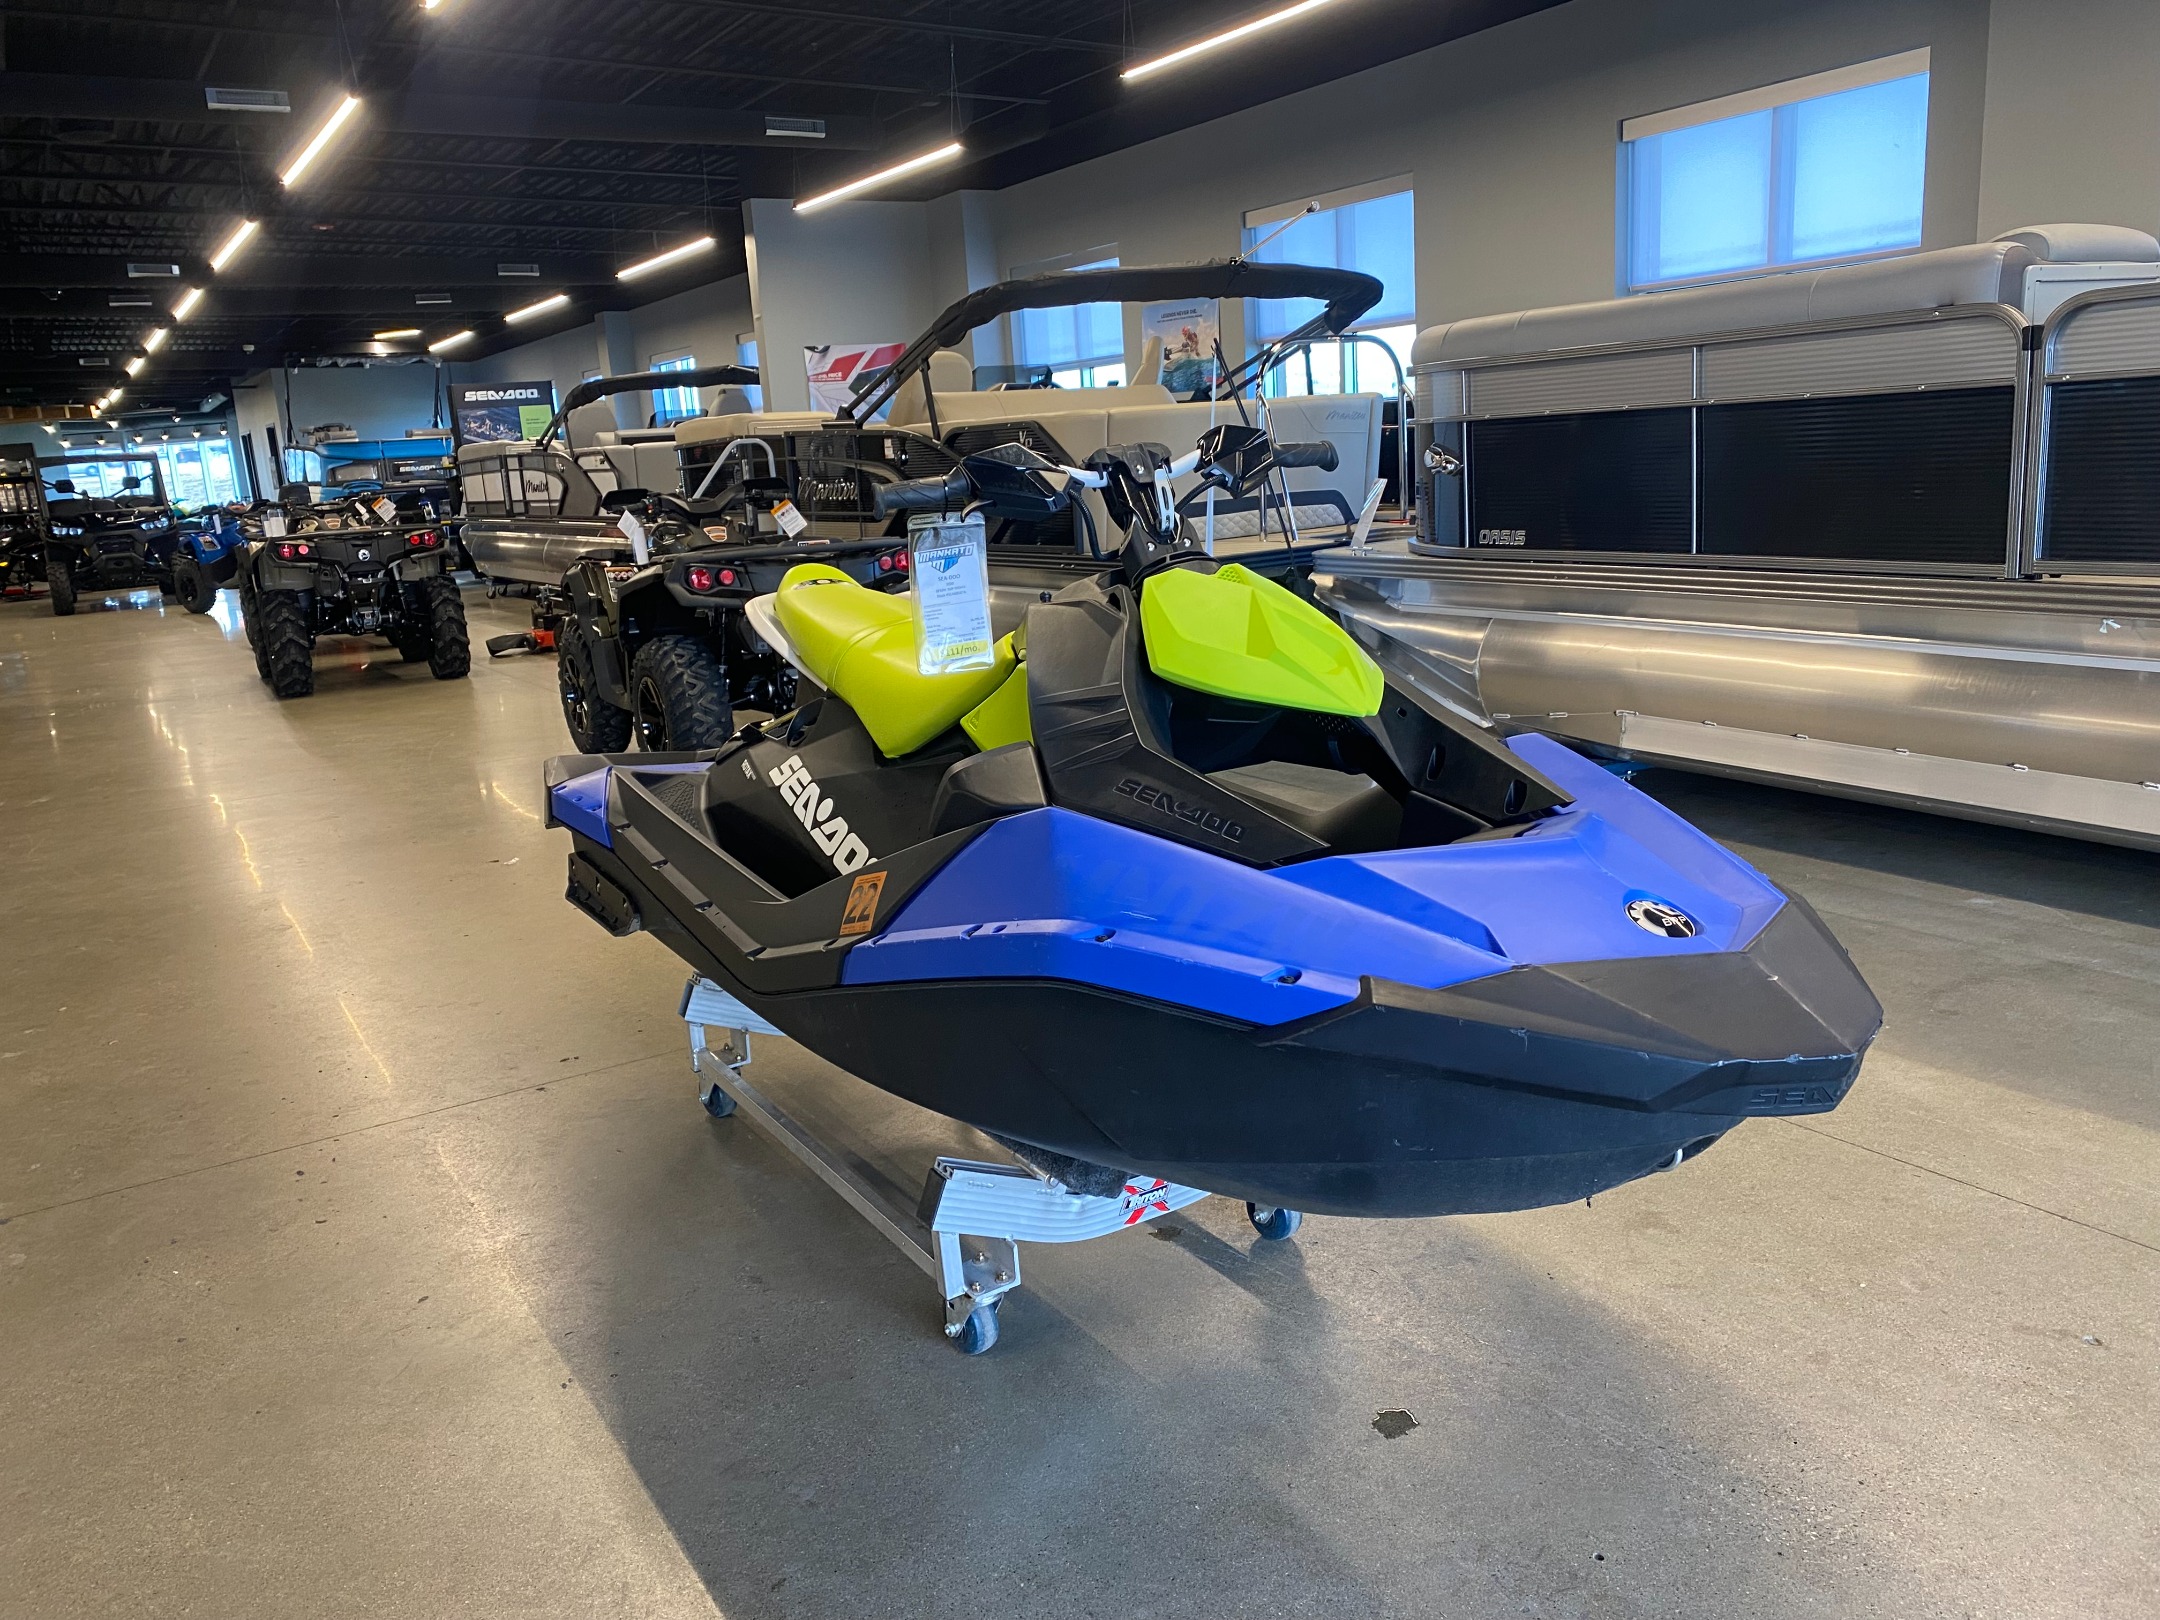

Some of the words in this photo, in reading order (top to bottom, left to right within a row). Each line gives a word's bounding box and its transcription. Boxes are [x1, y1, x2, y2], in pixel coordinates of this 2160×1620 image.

[797, 476, 858, 501] Manitou
[1479, 529, 1526, 546] OASIS
[918, 545, 974, 564] MANKATO
[843, 883, 878, 925] 22
[1127, 1187, 1167, 1208] TRITON
